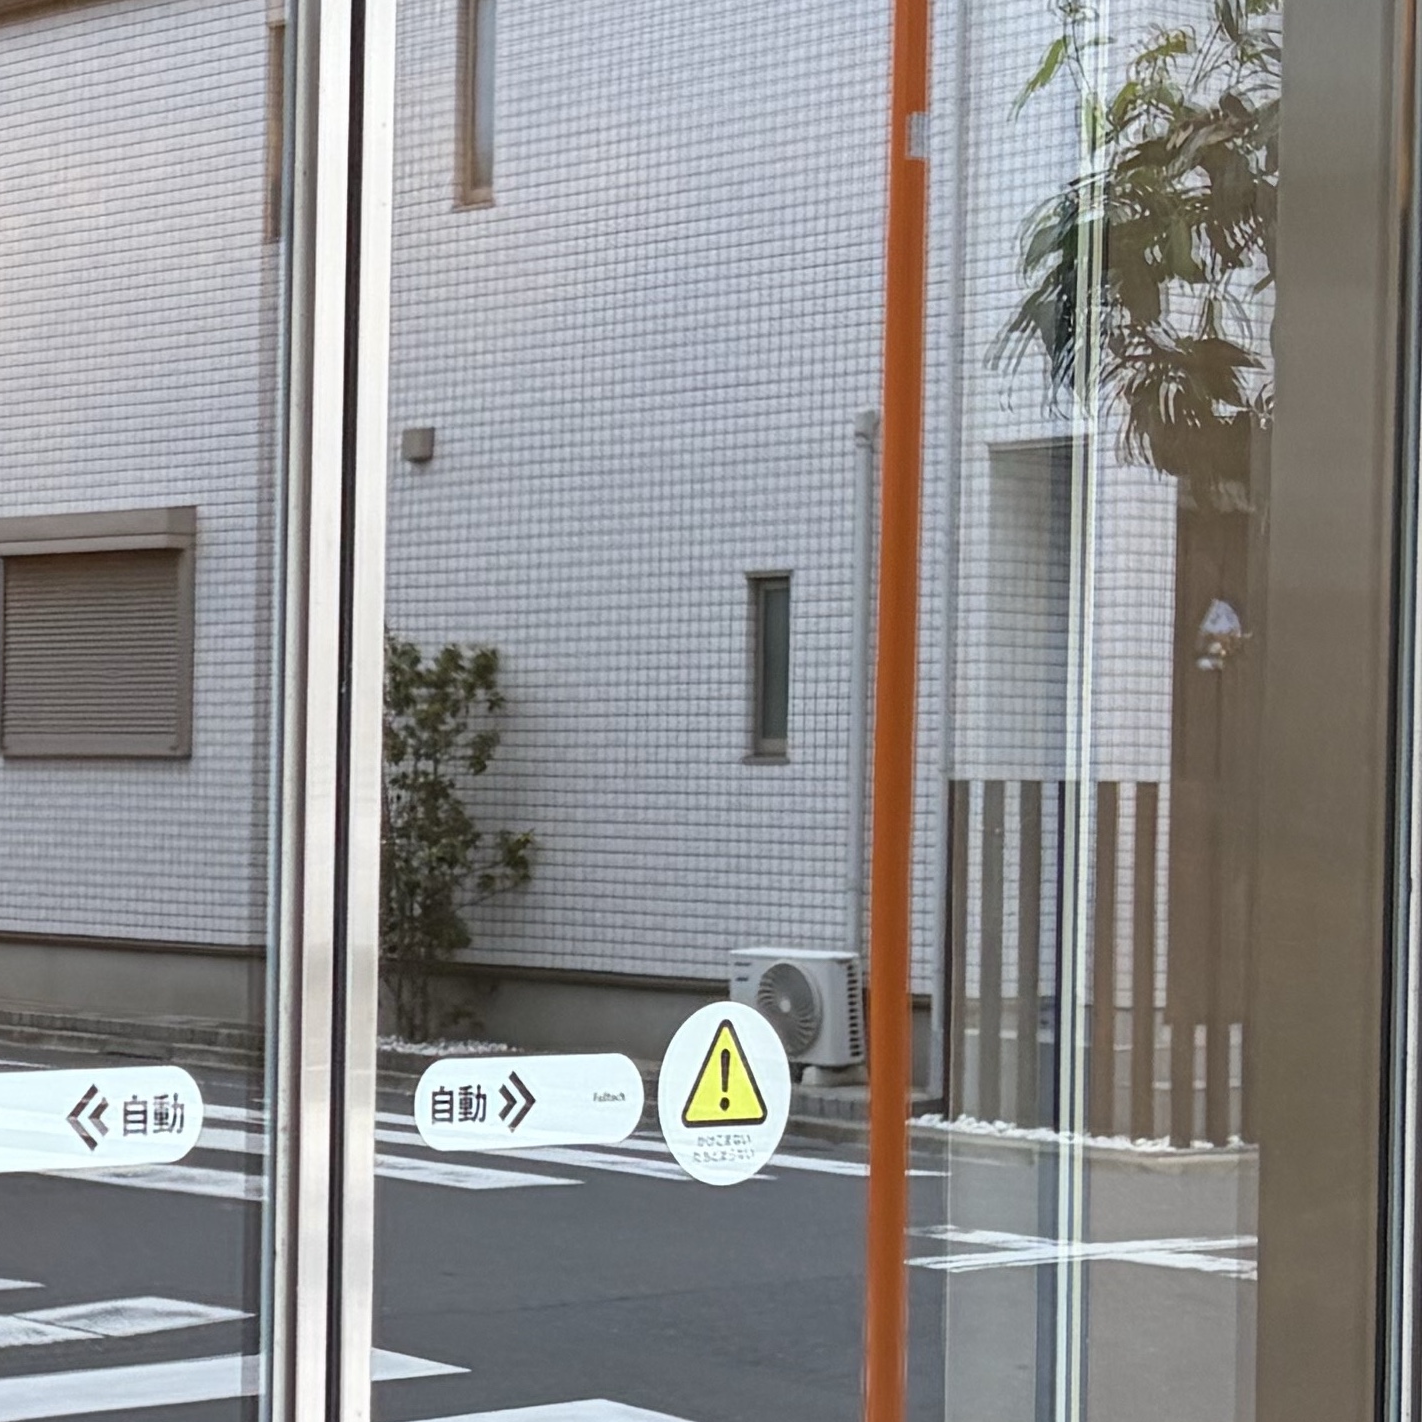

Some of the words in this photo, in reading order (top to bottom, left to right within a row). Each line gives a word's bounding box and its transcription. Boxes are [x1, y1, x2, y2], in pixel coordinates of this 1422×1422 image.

[123, 1093, 185, 1136] 自動
[431, 1084, 487, 1125] 自動
[697, 1134, 751, 1147] かけこまない
